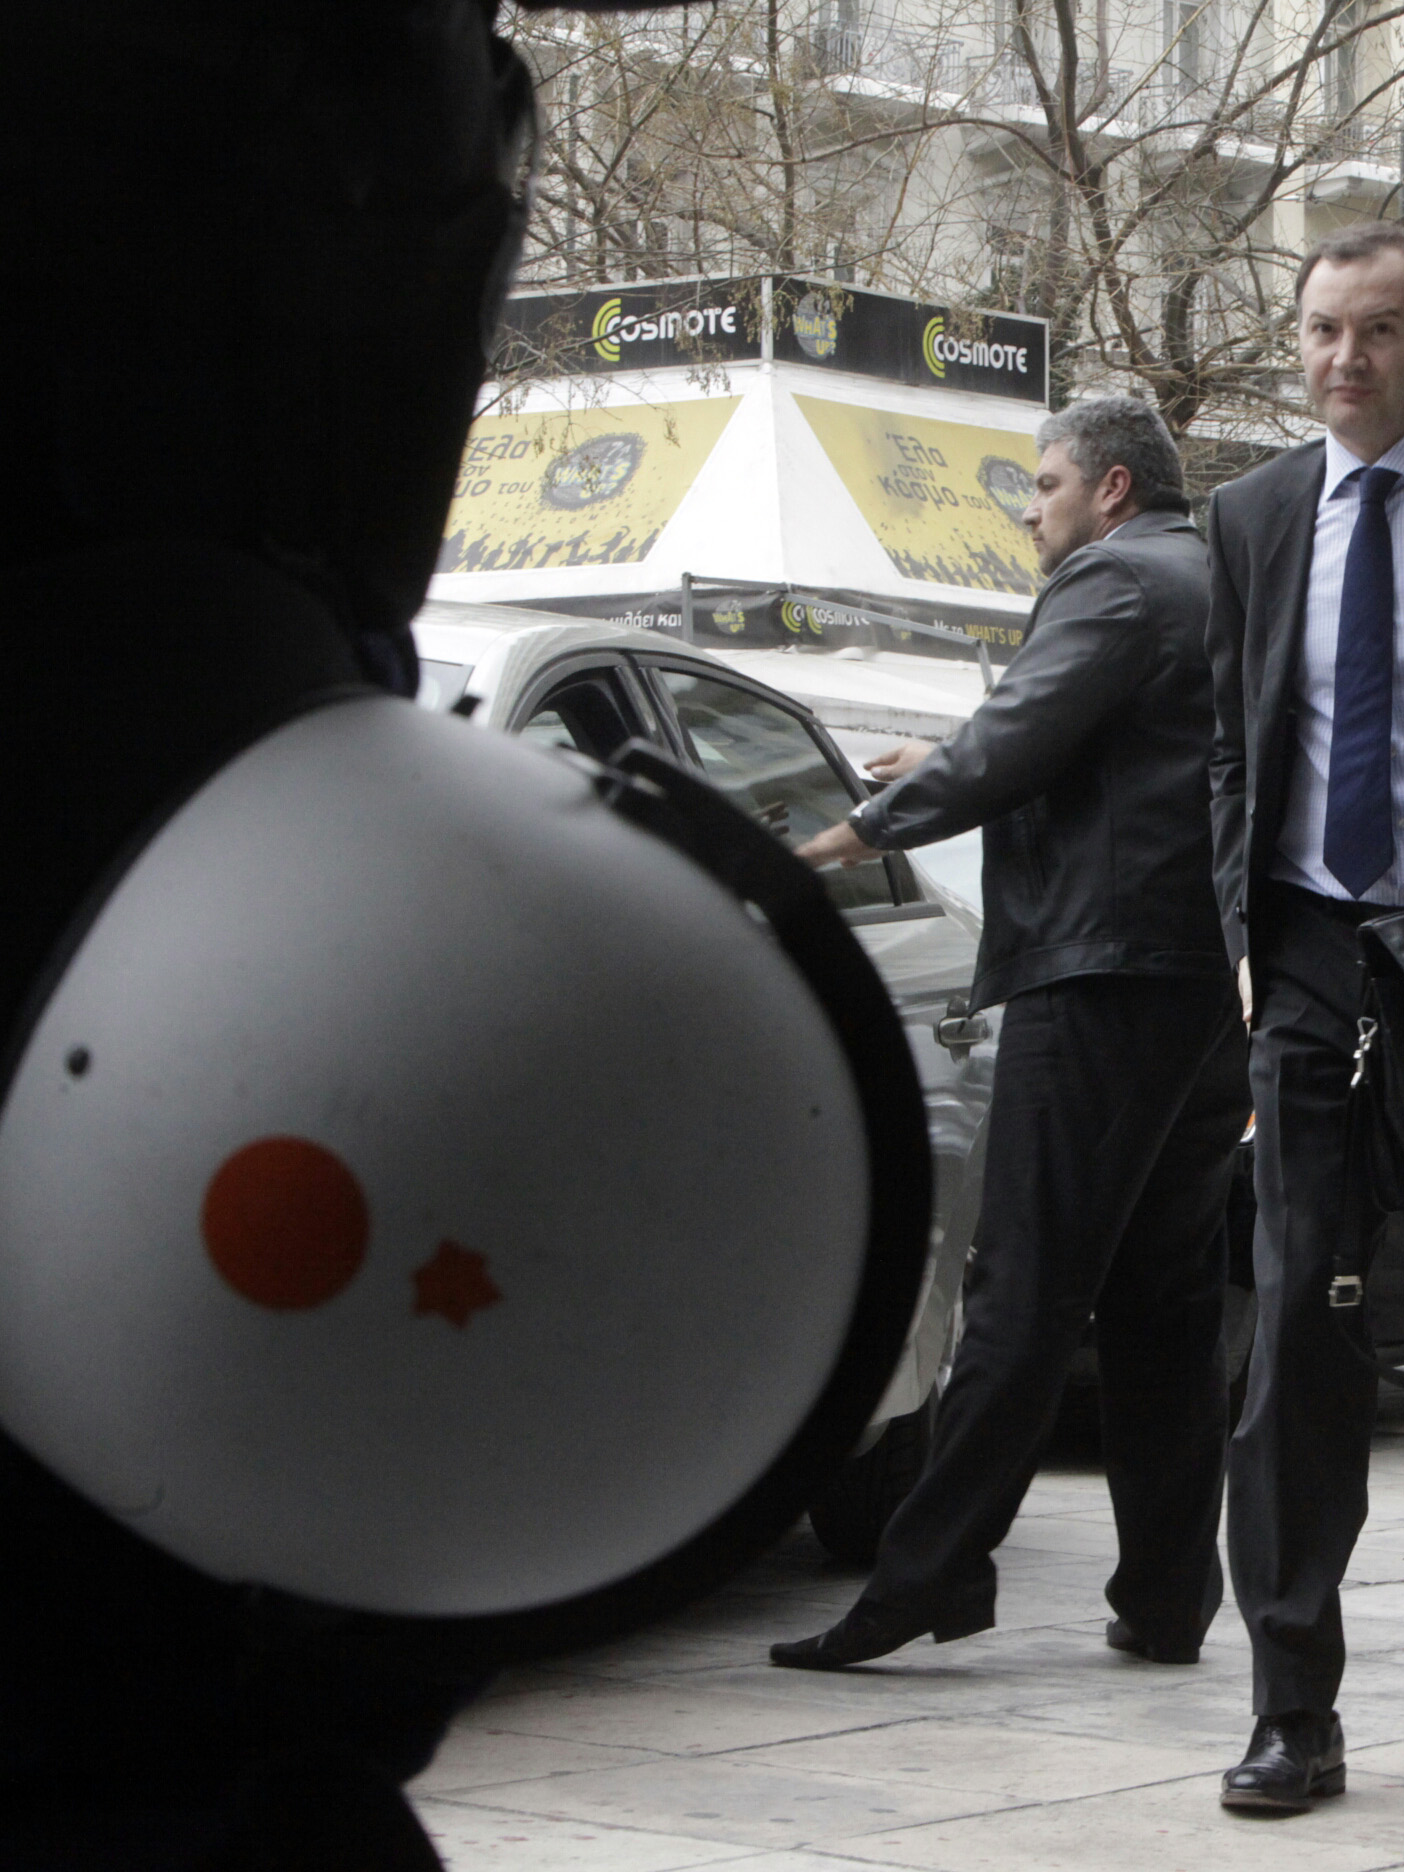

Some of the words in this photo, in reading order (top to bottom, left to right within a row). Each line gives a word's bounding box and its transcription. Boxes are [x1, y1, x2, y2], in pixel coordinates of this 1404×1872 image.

[606, 306, 736, 344] COSMOTE
[933, 334, 1028, 373] COSMOTE
[886, 432, 949, 468] Έλα
[877, 468, 960, 511] κόσμο
